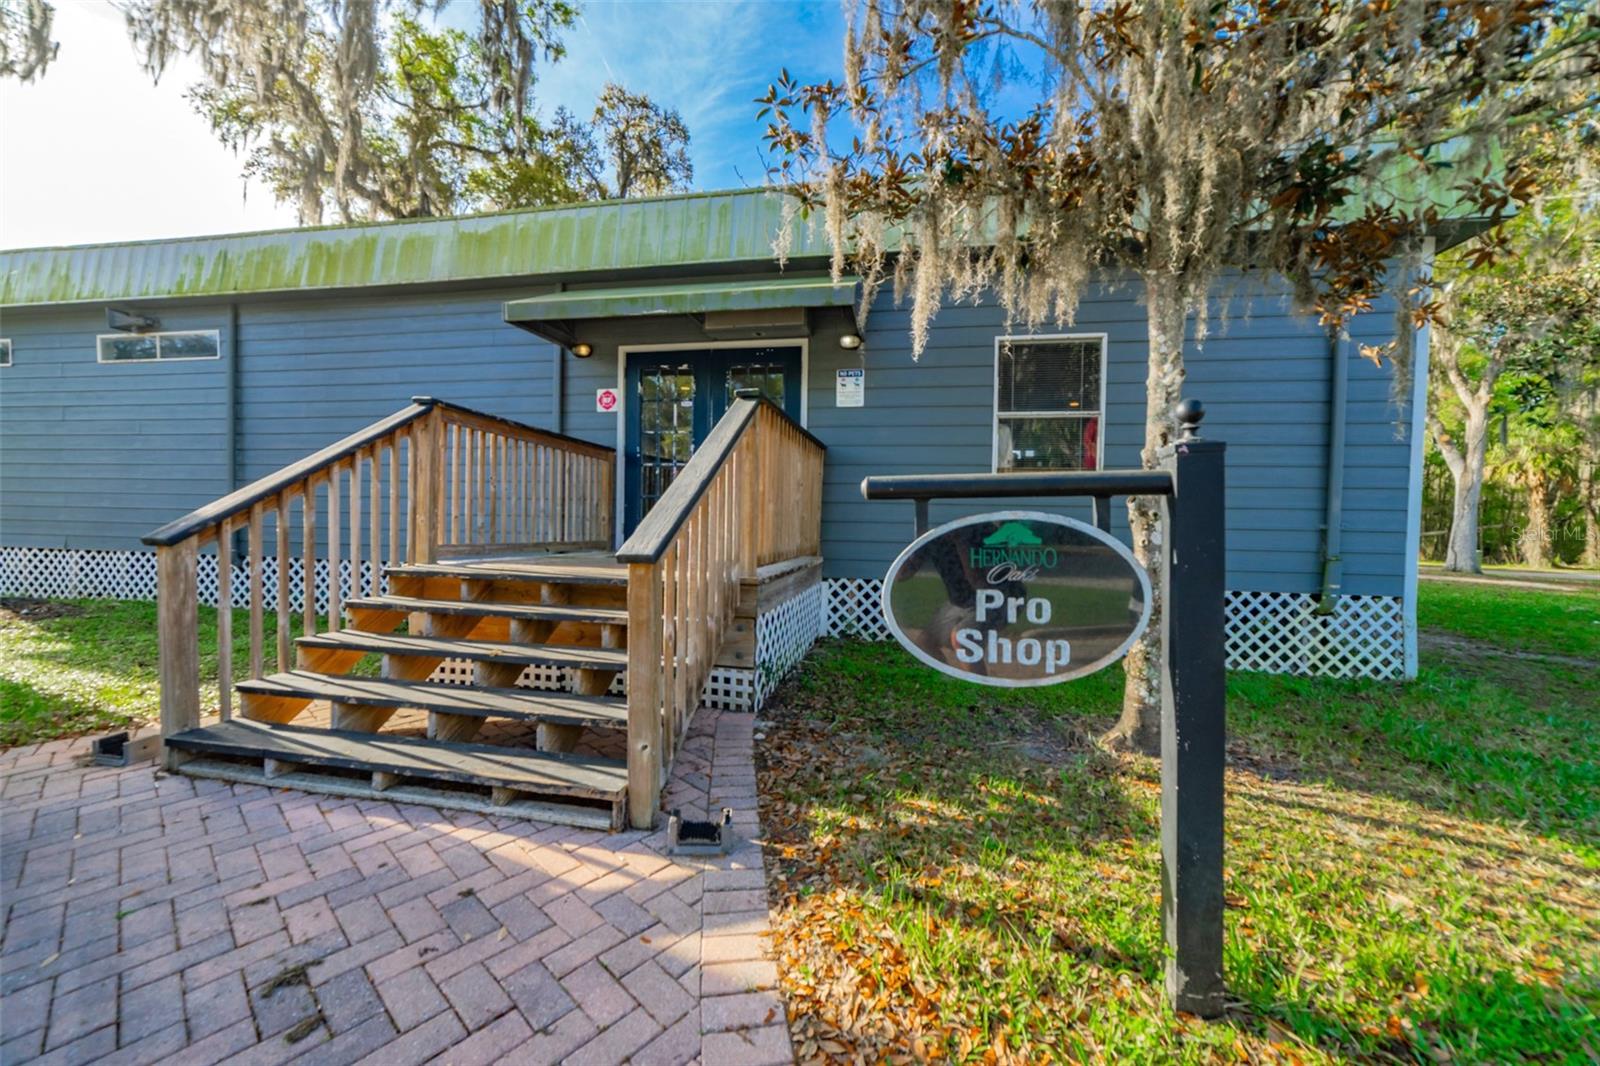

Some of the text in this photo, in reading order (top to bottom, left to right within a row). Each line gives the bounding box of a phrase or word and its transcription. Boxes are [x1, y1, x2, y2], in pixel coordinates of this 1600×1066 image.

[970, 547, 1057, 569] HERNANDO
[986, 561, 1040, 584] Oaks
[975, 589, 1052, 625] Pro
[955, 628, 1071, 674] Shop
